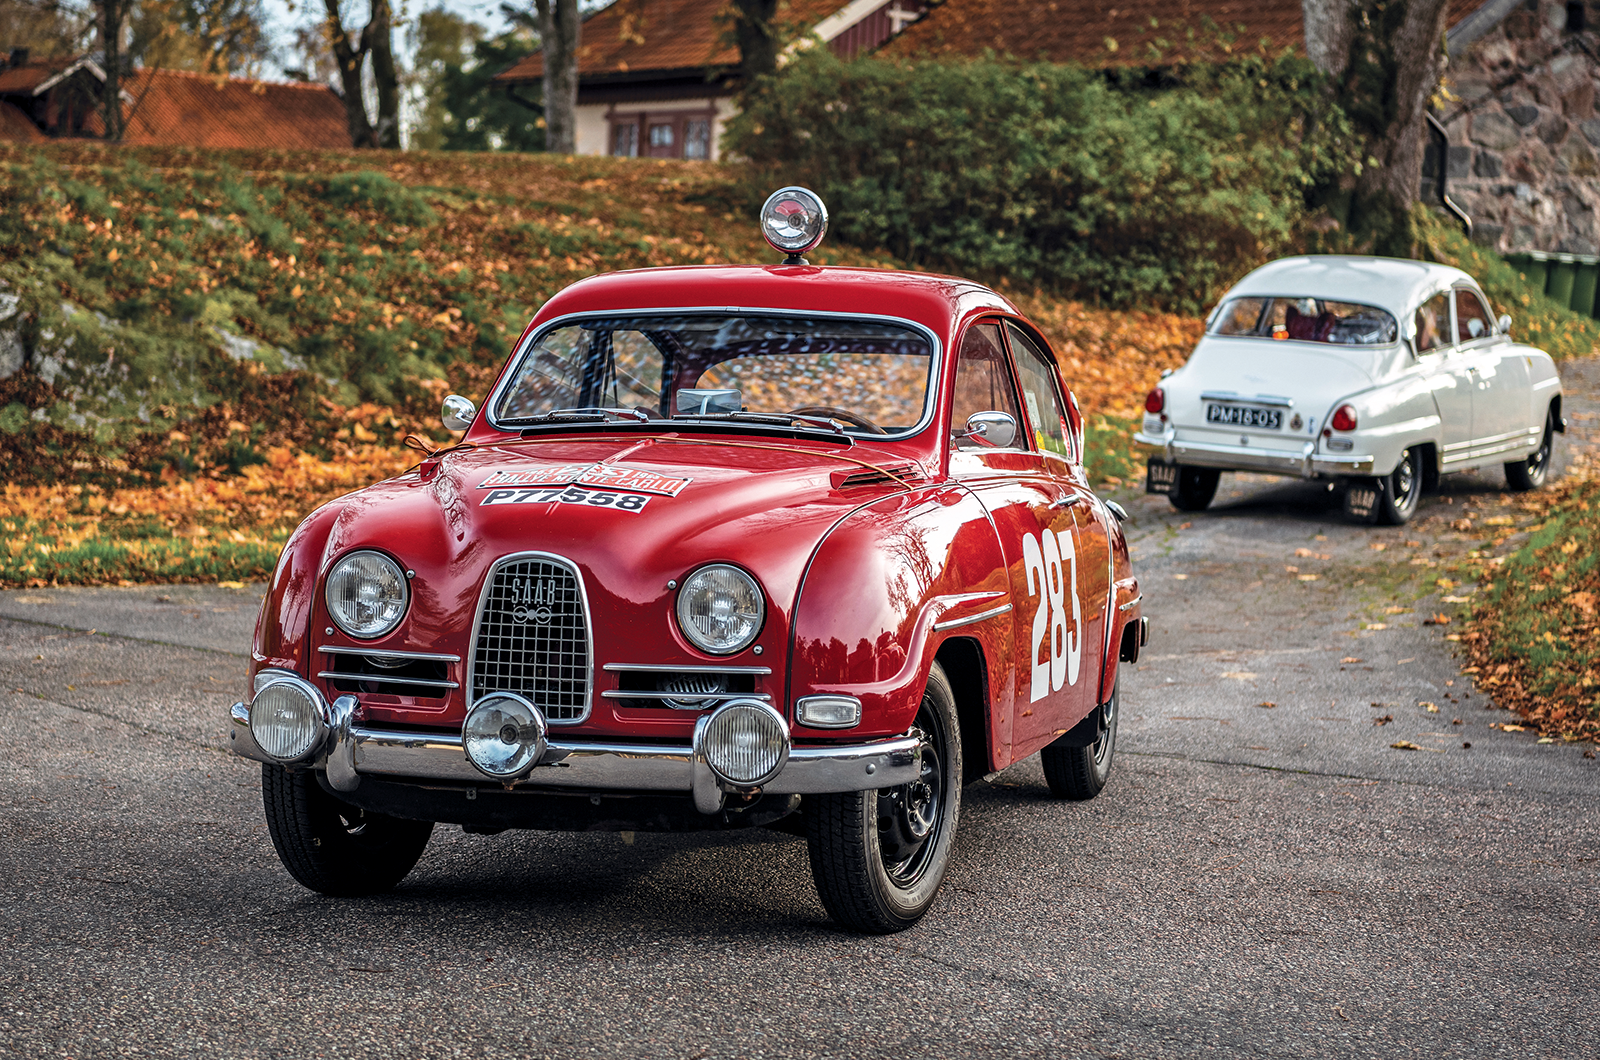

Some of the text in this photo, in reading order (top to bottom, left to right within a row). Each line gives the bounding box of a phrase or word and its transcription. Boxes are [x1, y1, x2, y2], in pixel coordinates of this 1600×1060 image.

[488, 473, 553, 485] RALLYE
[1150, 464, 1176, 483] SAAB
[483, 487, 647, 510] P77558
[1350, 489, 1376, 509] SAAB
[511, 578, 556, 606] SAAB
[1022, 528, 1082, 704] 283
